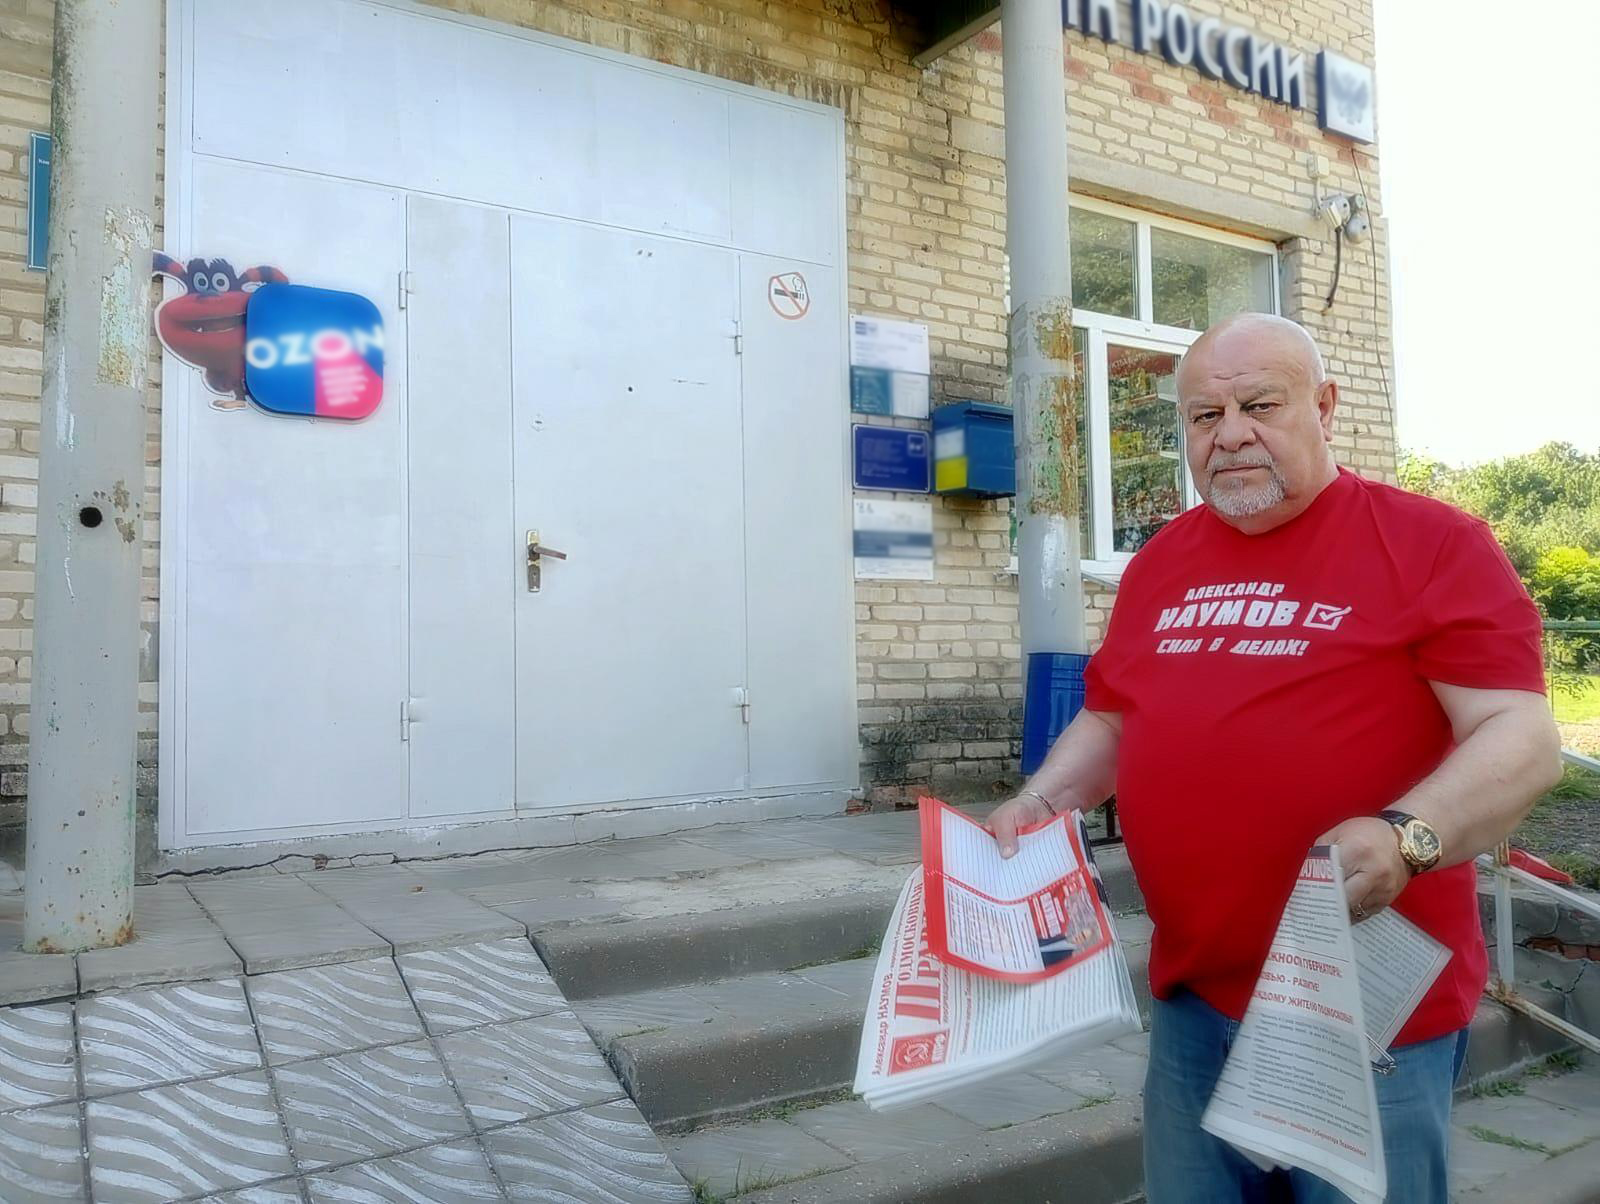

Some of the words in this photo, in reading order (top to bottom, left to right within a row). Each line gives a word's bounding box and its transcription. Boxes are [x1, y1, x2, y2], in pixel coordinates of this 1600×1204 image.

[1134, 0, 1307, 109] РОССИИ
[246, 324, 384, 370] OZON
[1184, 581, 1284, 601] АЛЕКСАНДР
[1153, 599, 1300, 632] НАУМОВ
[1156, 638, 1203, 654] СИЛА
[1229, 638, 1310, 656] ДЕЛАХ!
[877, 973, 893, 1020] НАУМОВ
